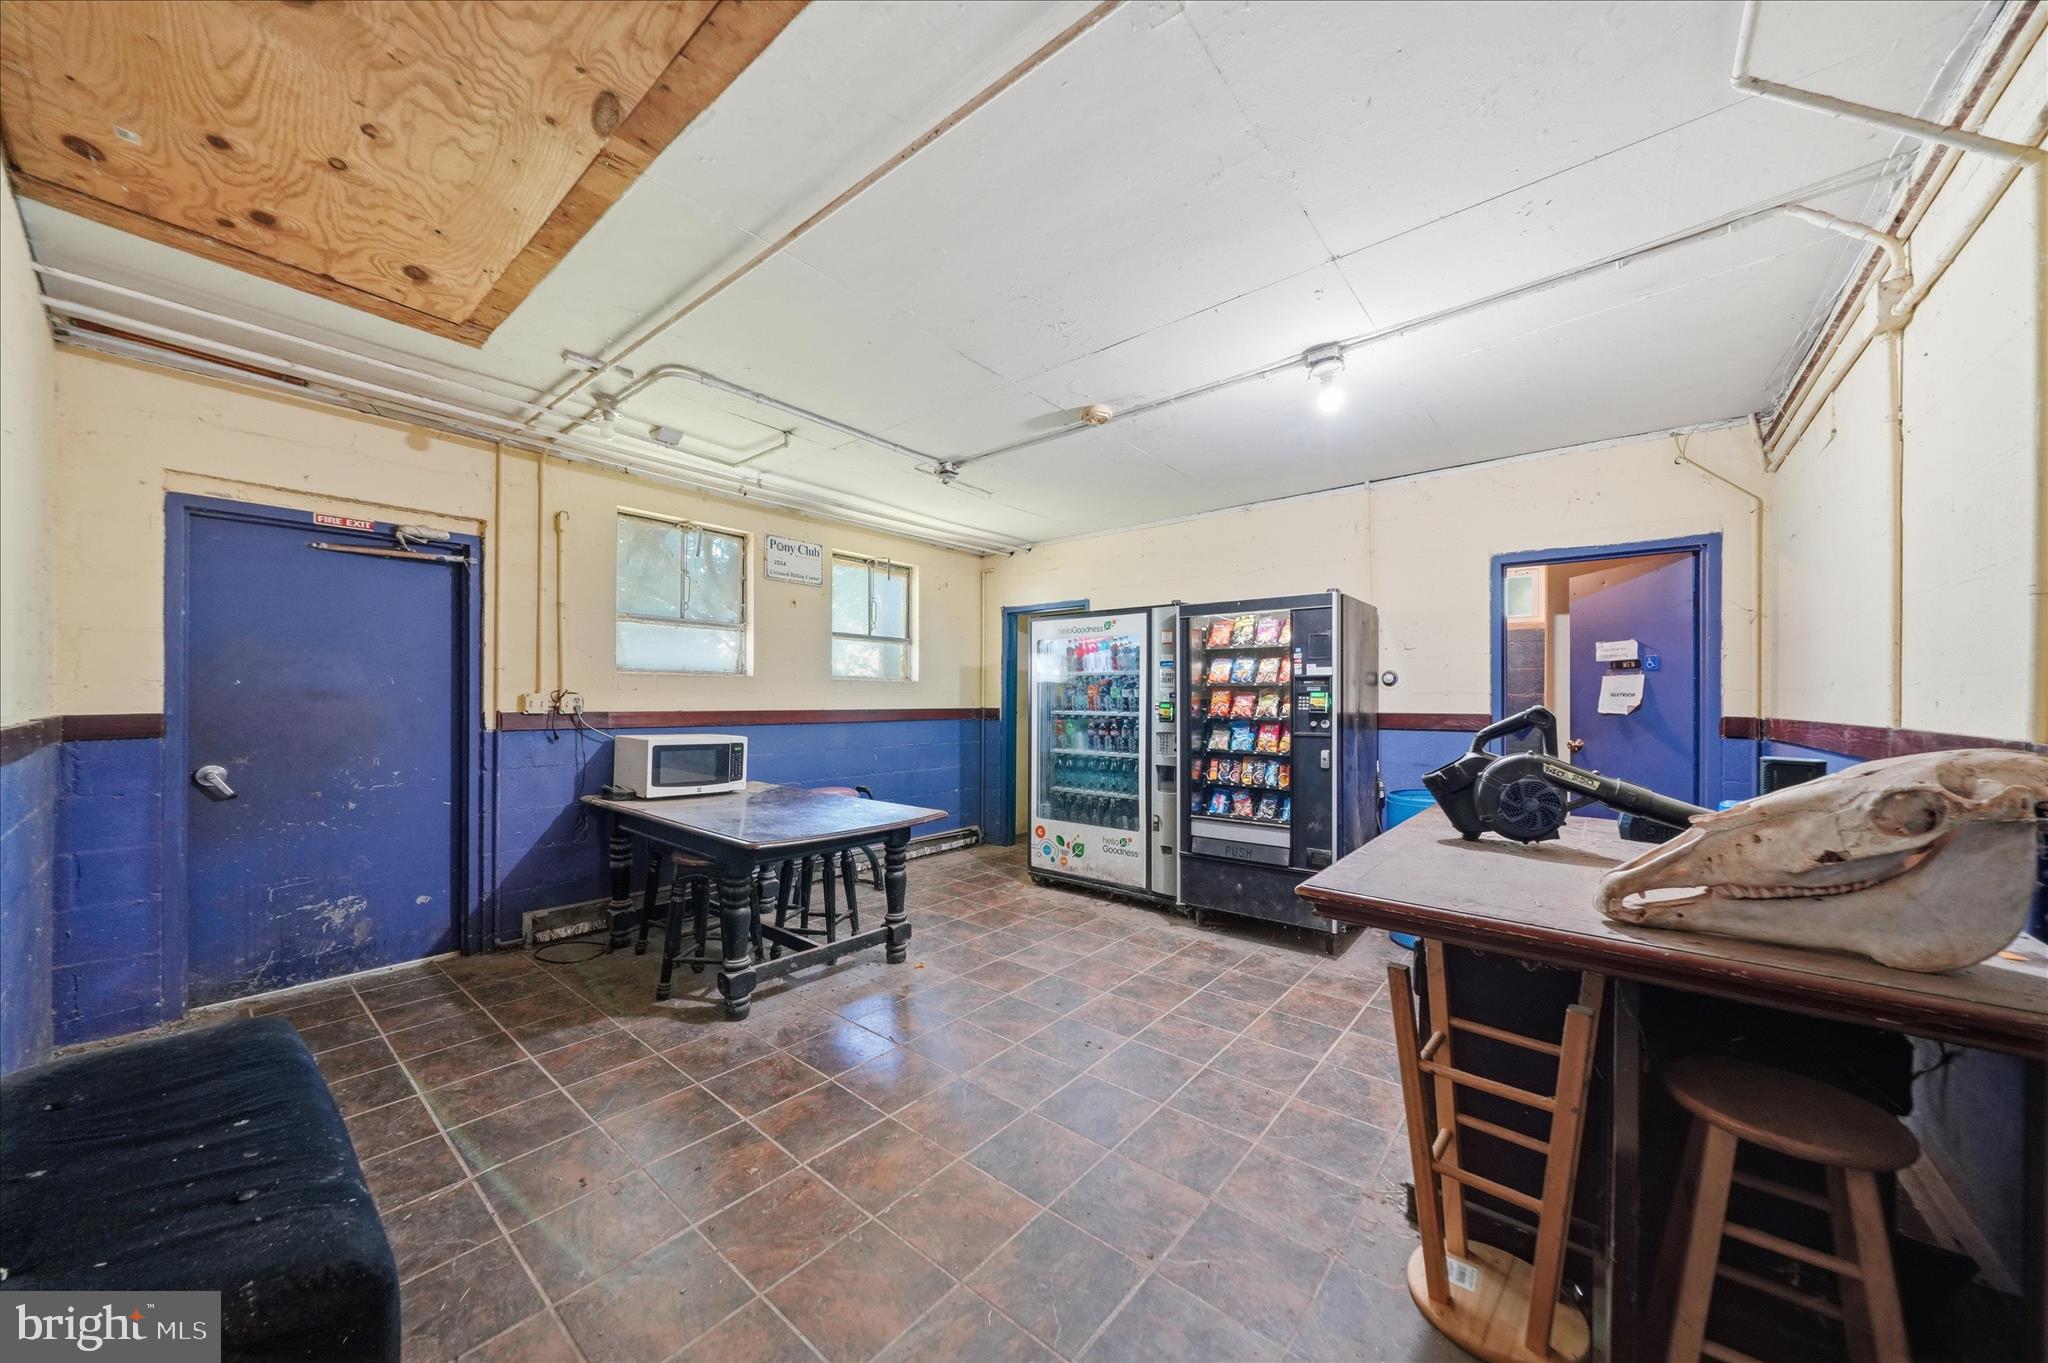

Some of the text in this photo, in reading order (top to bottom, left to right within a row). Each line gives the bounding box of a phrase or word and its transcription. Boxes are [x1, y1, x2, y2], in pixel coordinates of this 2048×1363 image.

[317, 515, 372, 529] FIRE EXIT
[770, 539, 820, 557] Pony Club
[1102, 845, 1139, 858] Goodness
[1225, 846, 1253, 859] PUSH
